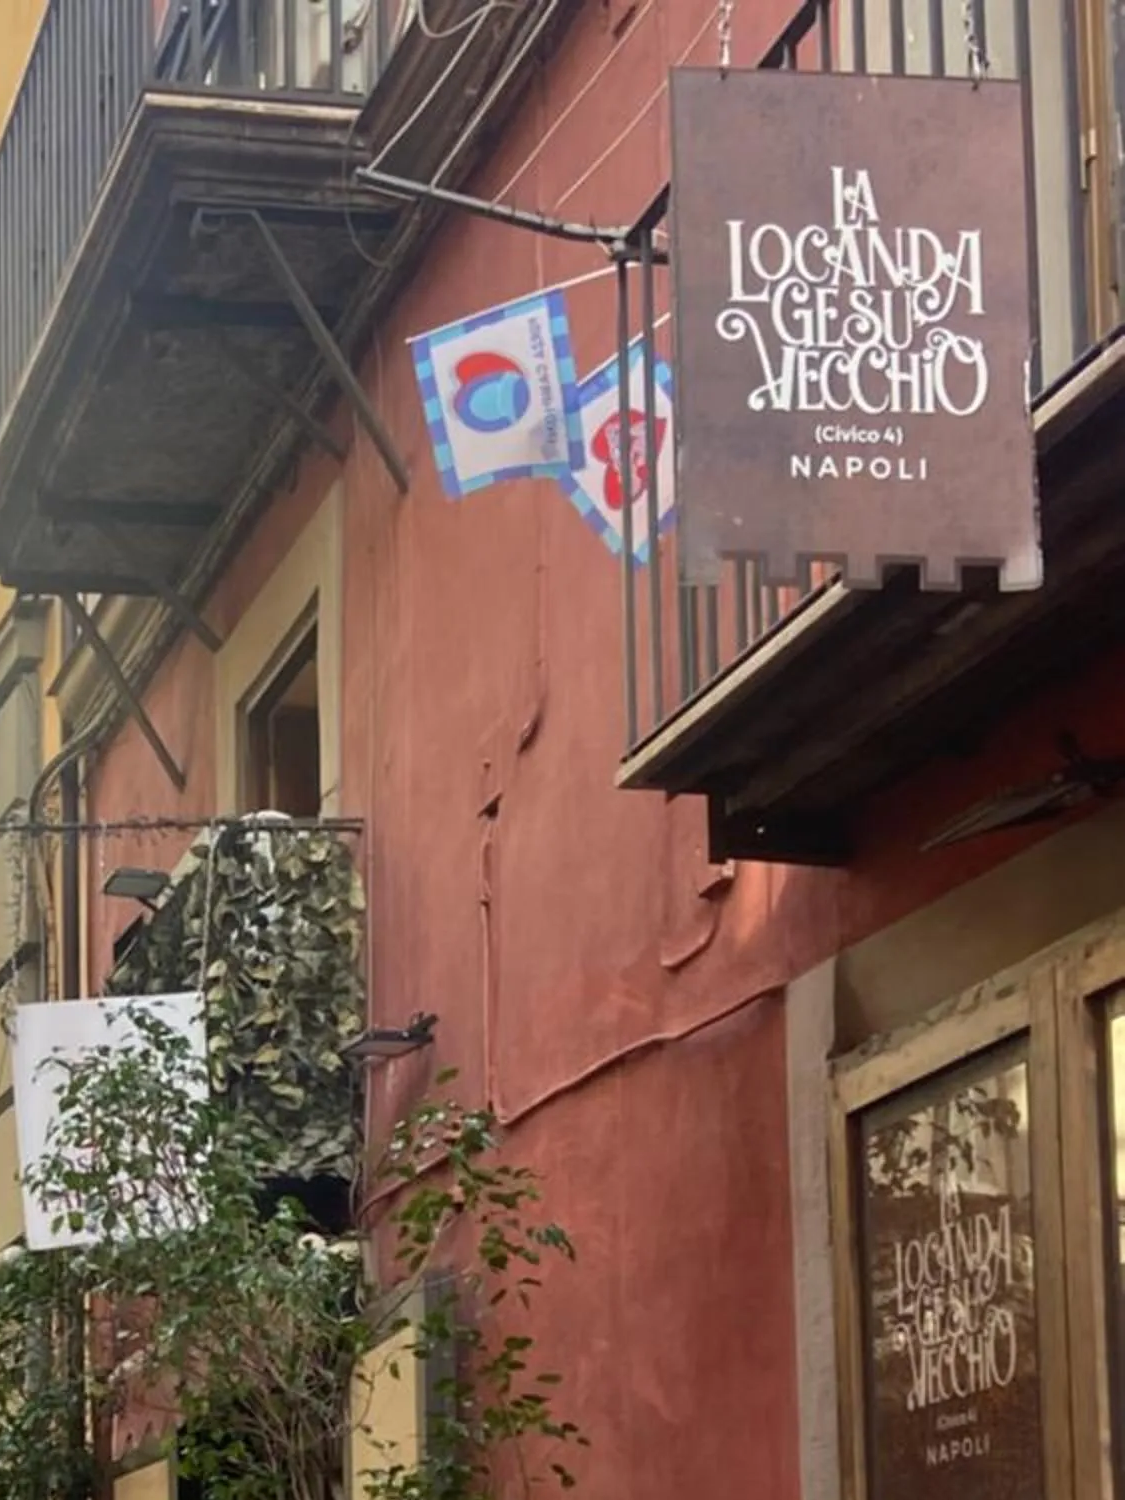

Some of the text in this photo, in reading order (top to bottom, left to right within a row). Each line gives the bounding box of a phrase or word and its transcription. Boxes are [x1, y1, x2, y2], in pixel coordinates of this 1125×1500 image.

[831, 165, 880, 229] LA
[725, 219, 986, 323] LOCANDA
[815, 424, 904, 447] (Civico 4)
[790, 454, 927, 480] NAPOLI
[894, 1203, 1014, 1315] LOCANDA
[926, 1432, 990, 1466] NAPOLI
